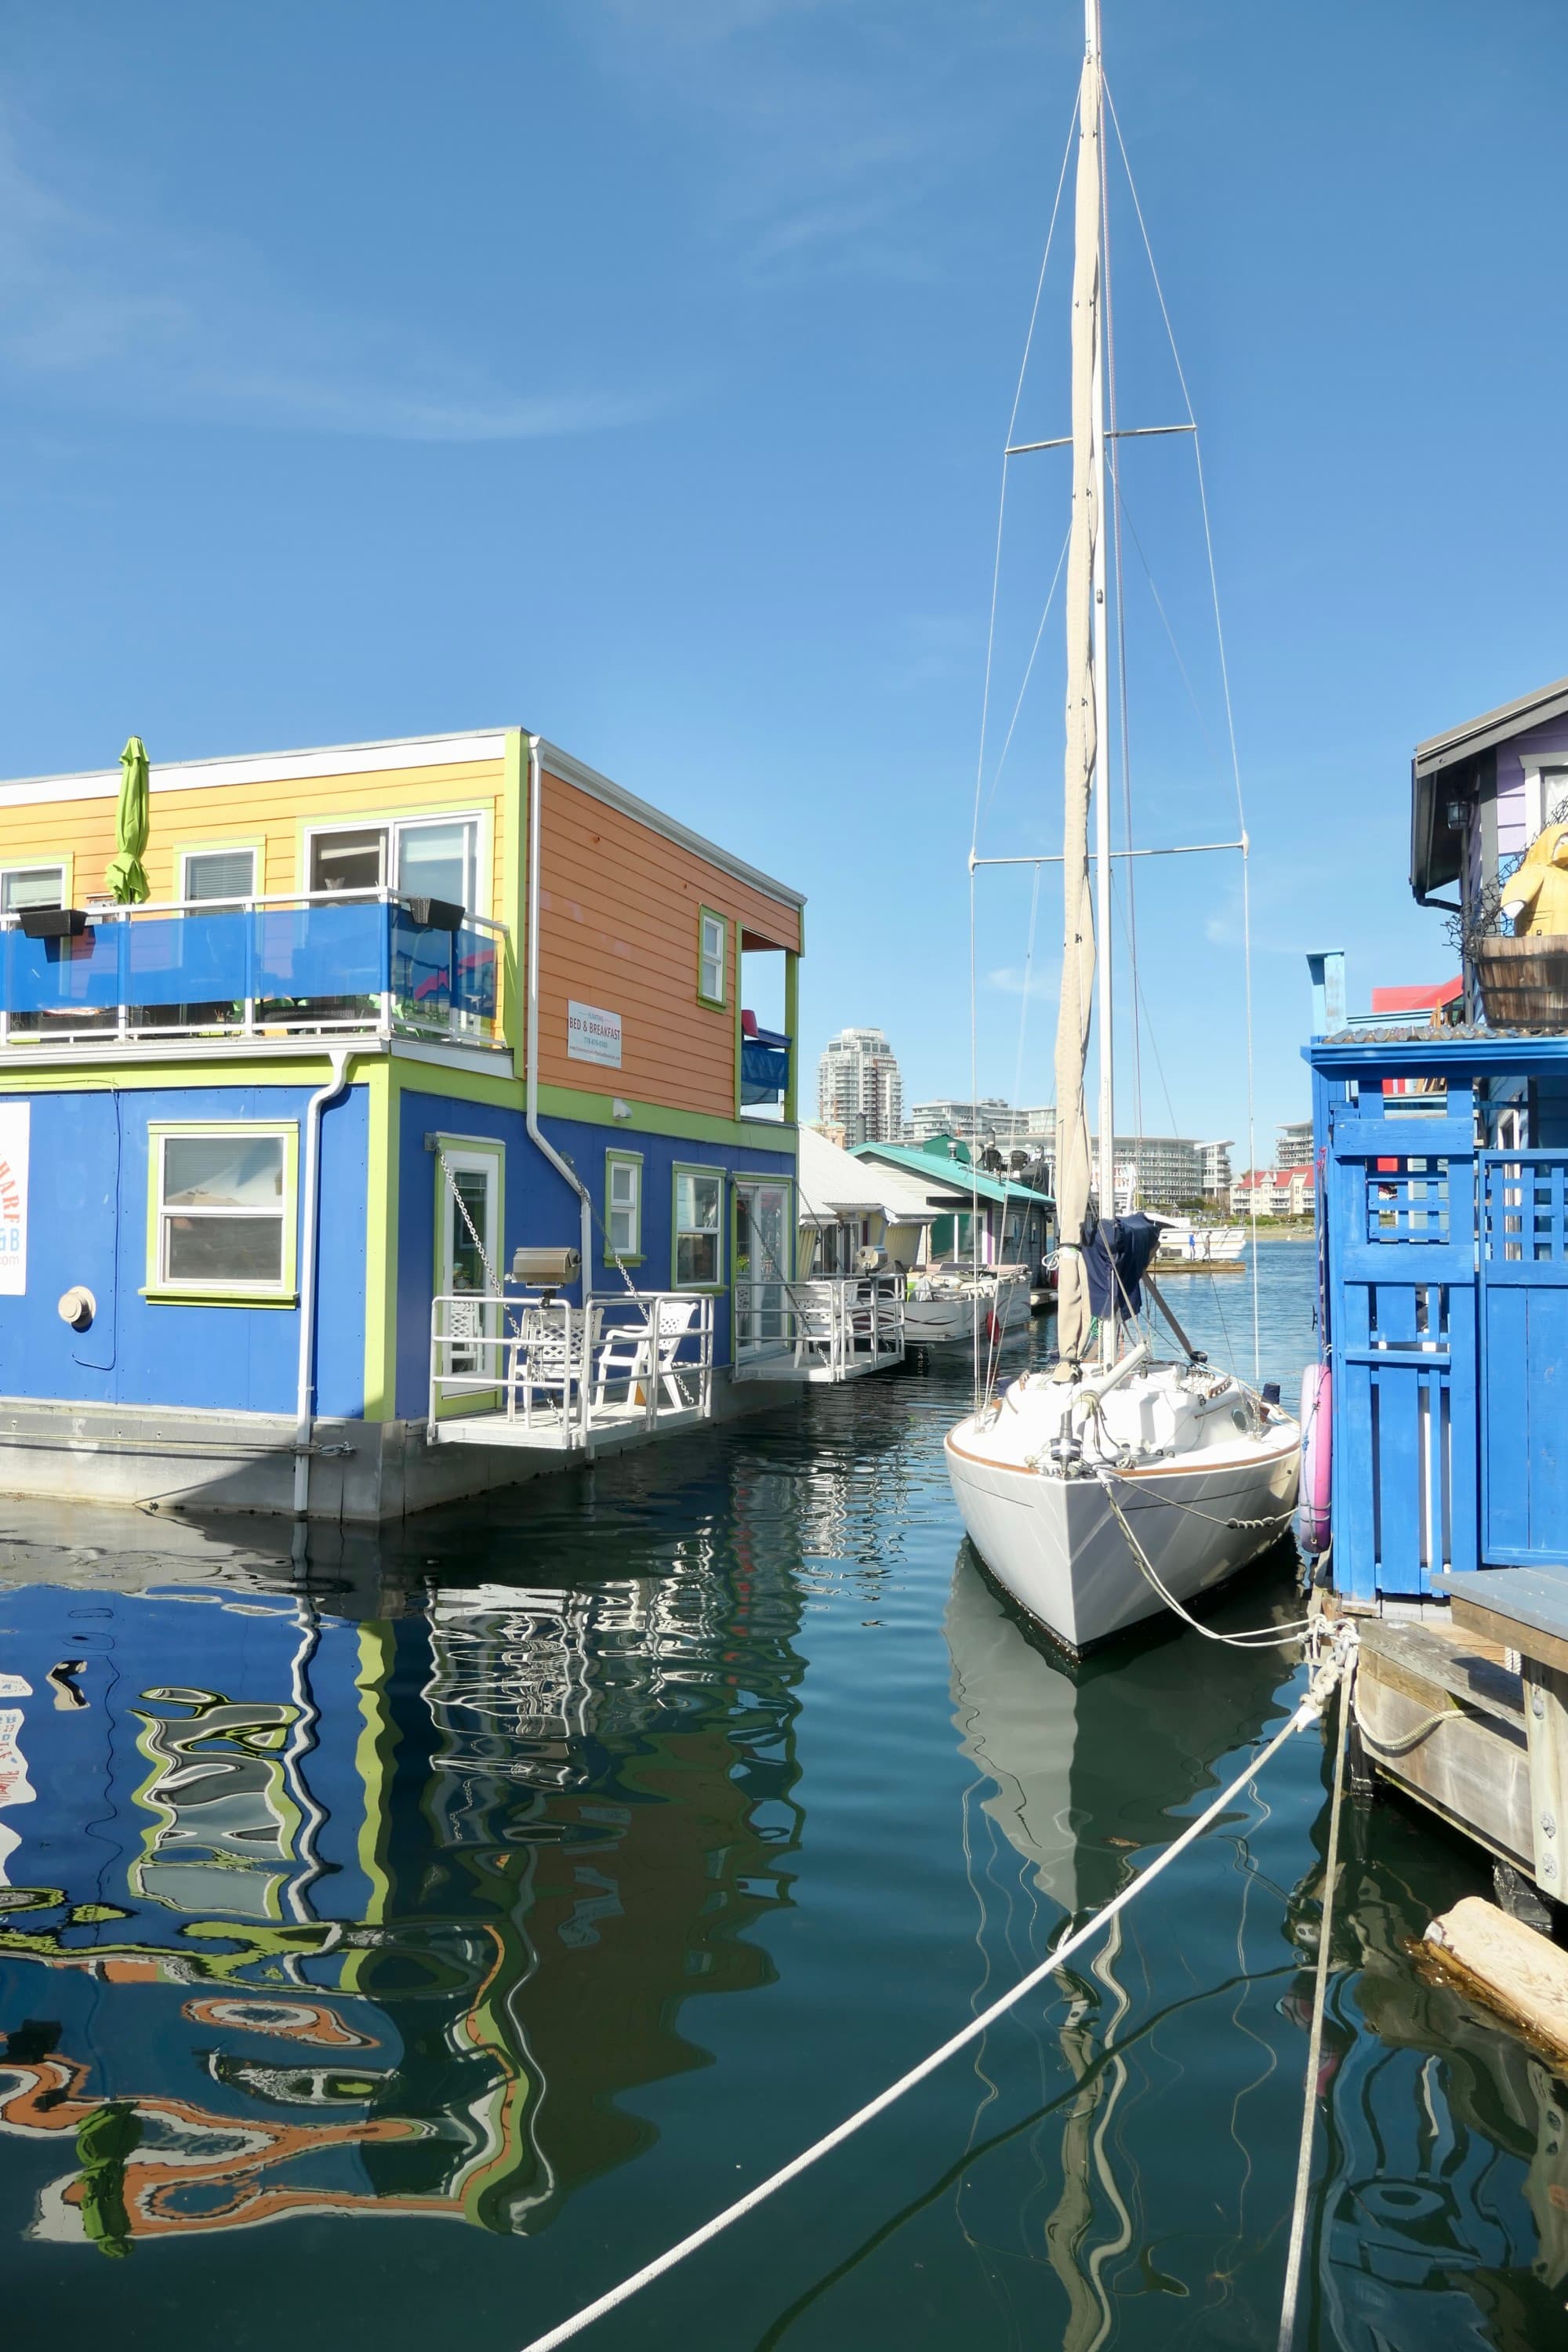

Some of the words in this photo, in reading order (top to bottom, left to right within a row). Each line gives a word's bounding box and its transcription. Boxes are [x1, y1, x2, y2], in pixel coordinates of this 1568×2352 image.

[569, 1016, 581, 1030] BED
[583, 1021, 588, 1032] &
[589, 1022, 620, 1040] BREAKFAST
[0, 1155, 20, 1223] HARF
